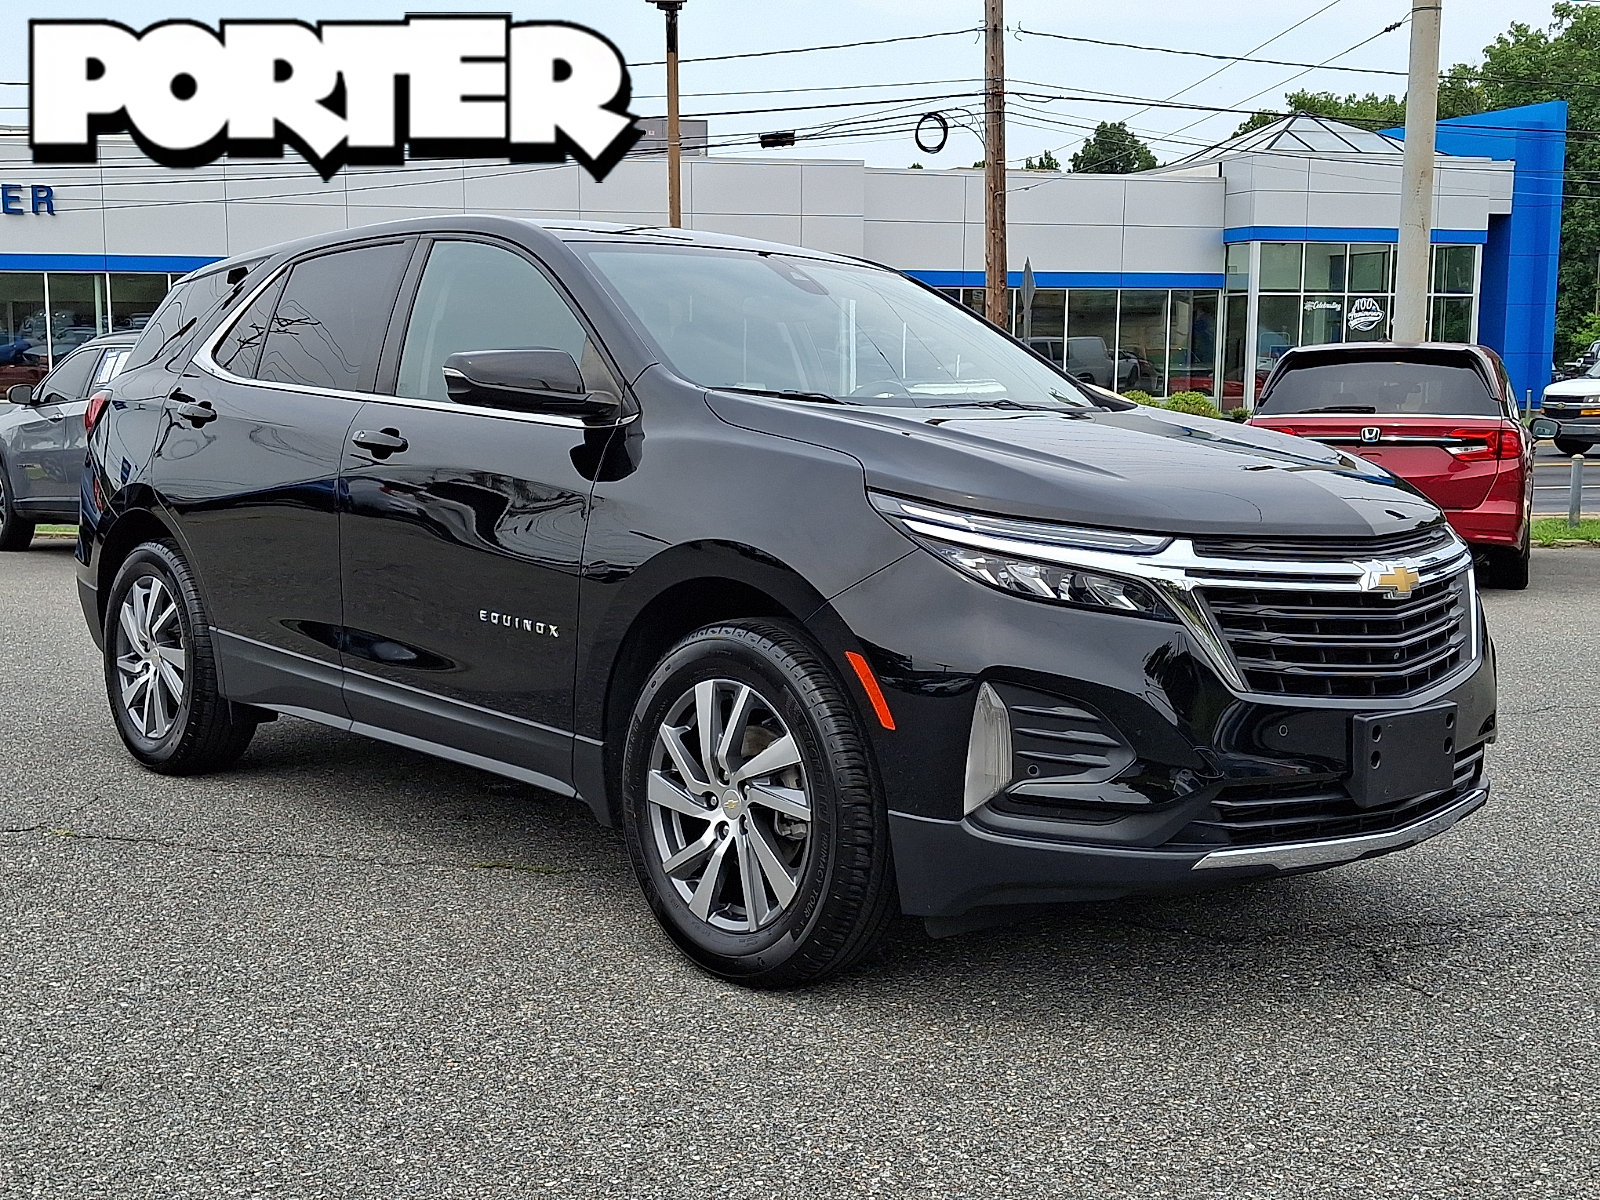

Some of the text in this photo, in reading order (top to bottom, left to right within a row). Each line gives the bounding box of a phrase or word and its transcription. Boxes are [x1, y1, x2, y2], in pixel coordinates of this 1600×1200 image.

[479, 609, 560, 638] EQUINOX
[803, 832, 829, 919] PRIMACY TOUR
